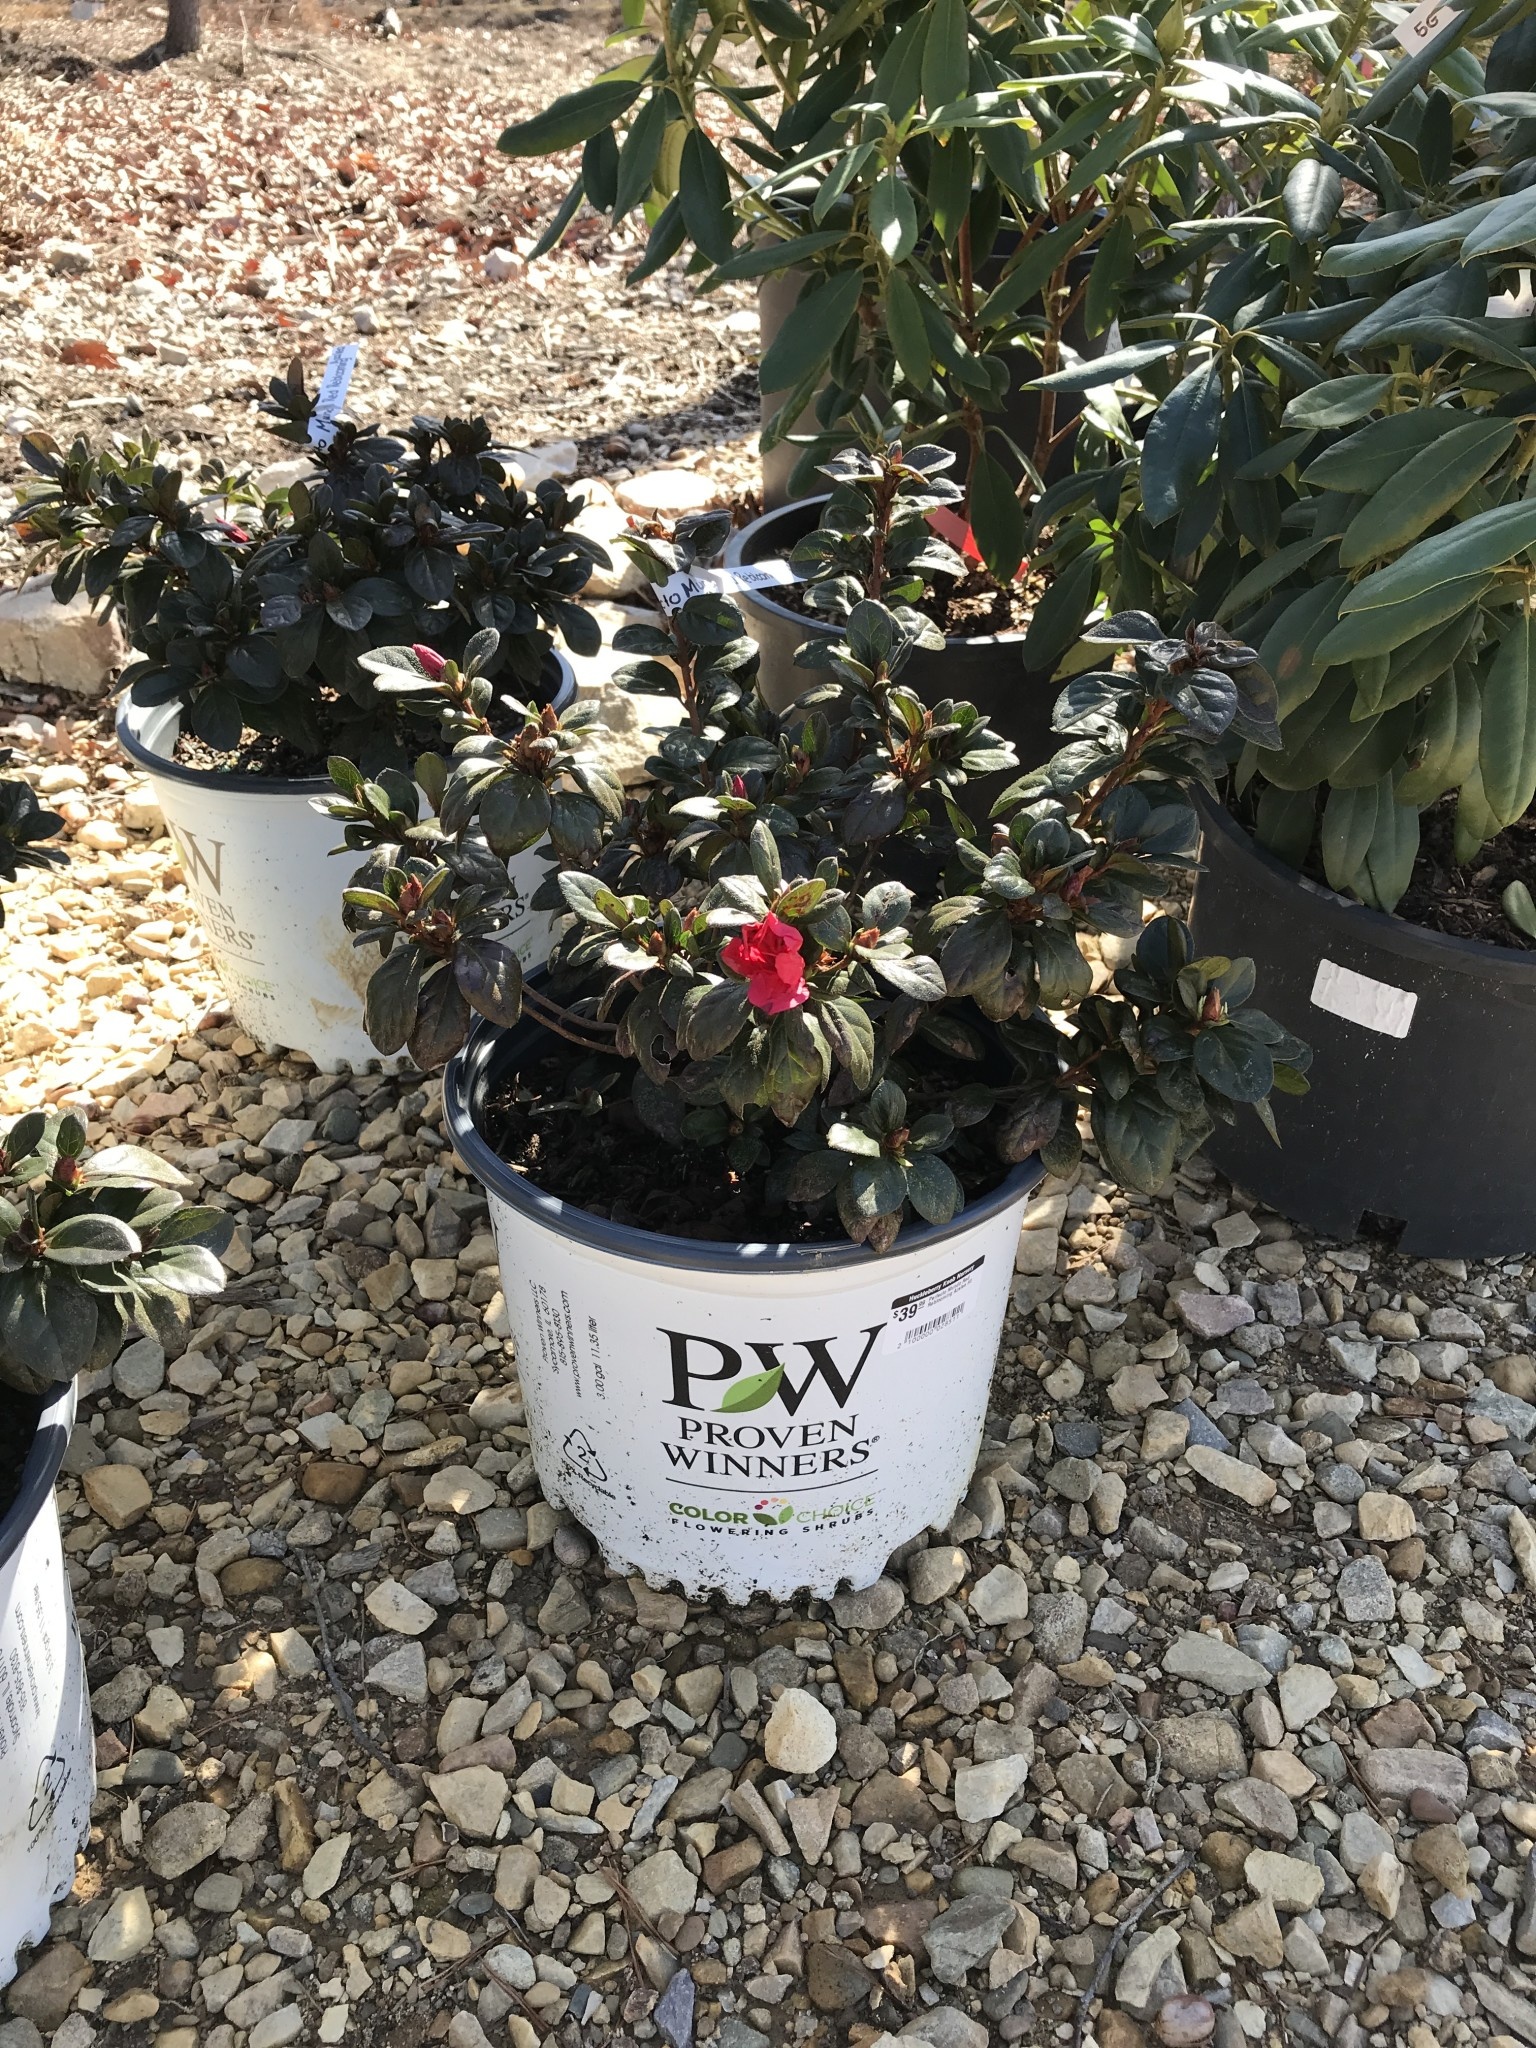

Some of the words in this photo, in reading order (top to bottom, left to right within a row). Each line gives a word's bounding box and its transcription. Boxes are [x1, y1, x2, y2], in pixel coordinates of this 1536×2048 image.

[168, 819, 226, 897] W
[561, 1290, 582, 1398] www.provenwinners.com
[593, 1362, 606, 1380] gal
[656, 1322, 888, 1417] PW
[594, 1379, 606, 1400] 3.00
[677, 1413, 860, 1449] PROVEN
[669, 1502, 748, 1525] COLOR
[796, 1492, 877, 1524] CHOICE
[671, 1517, 789, 1536] FLOWERING
[802, 1508, 874, 1533] SHRUBS
